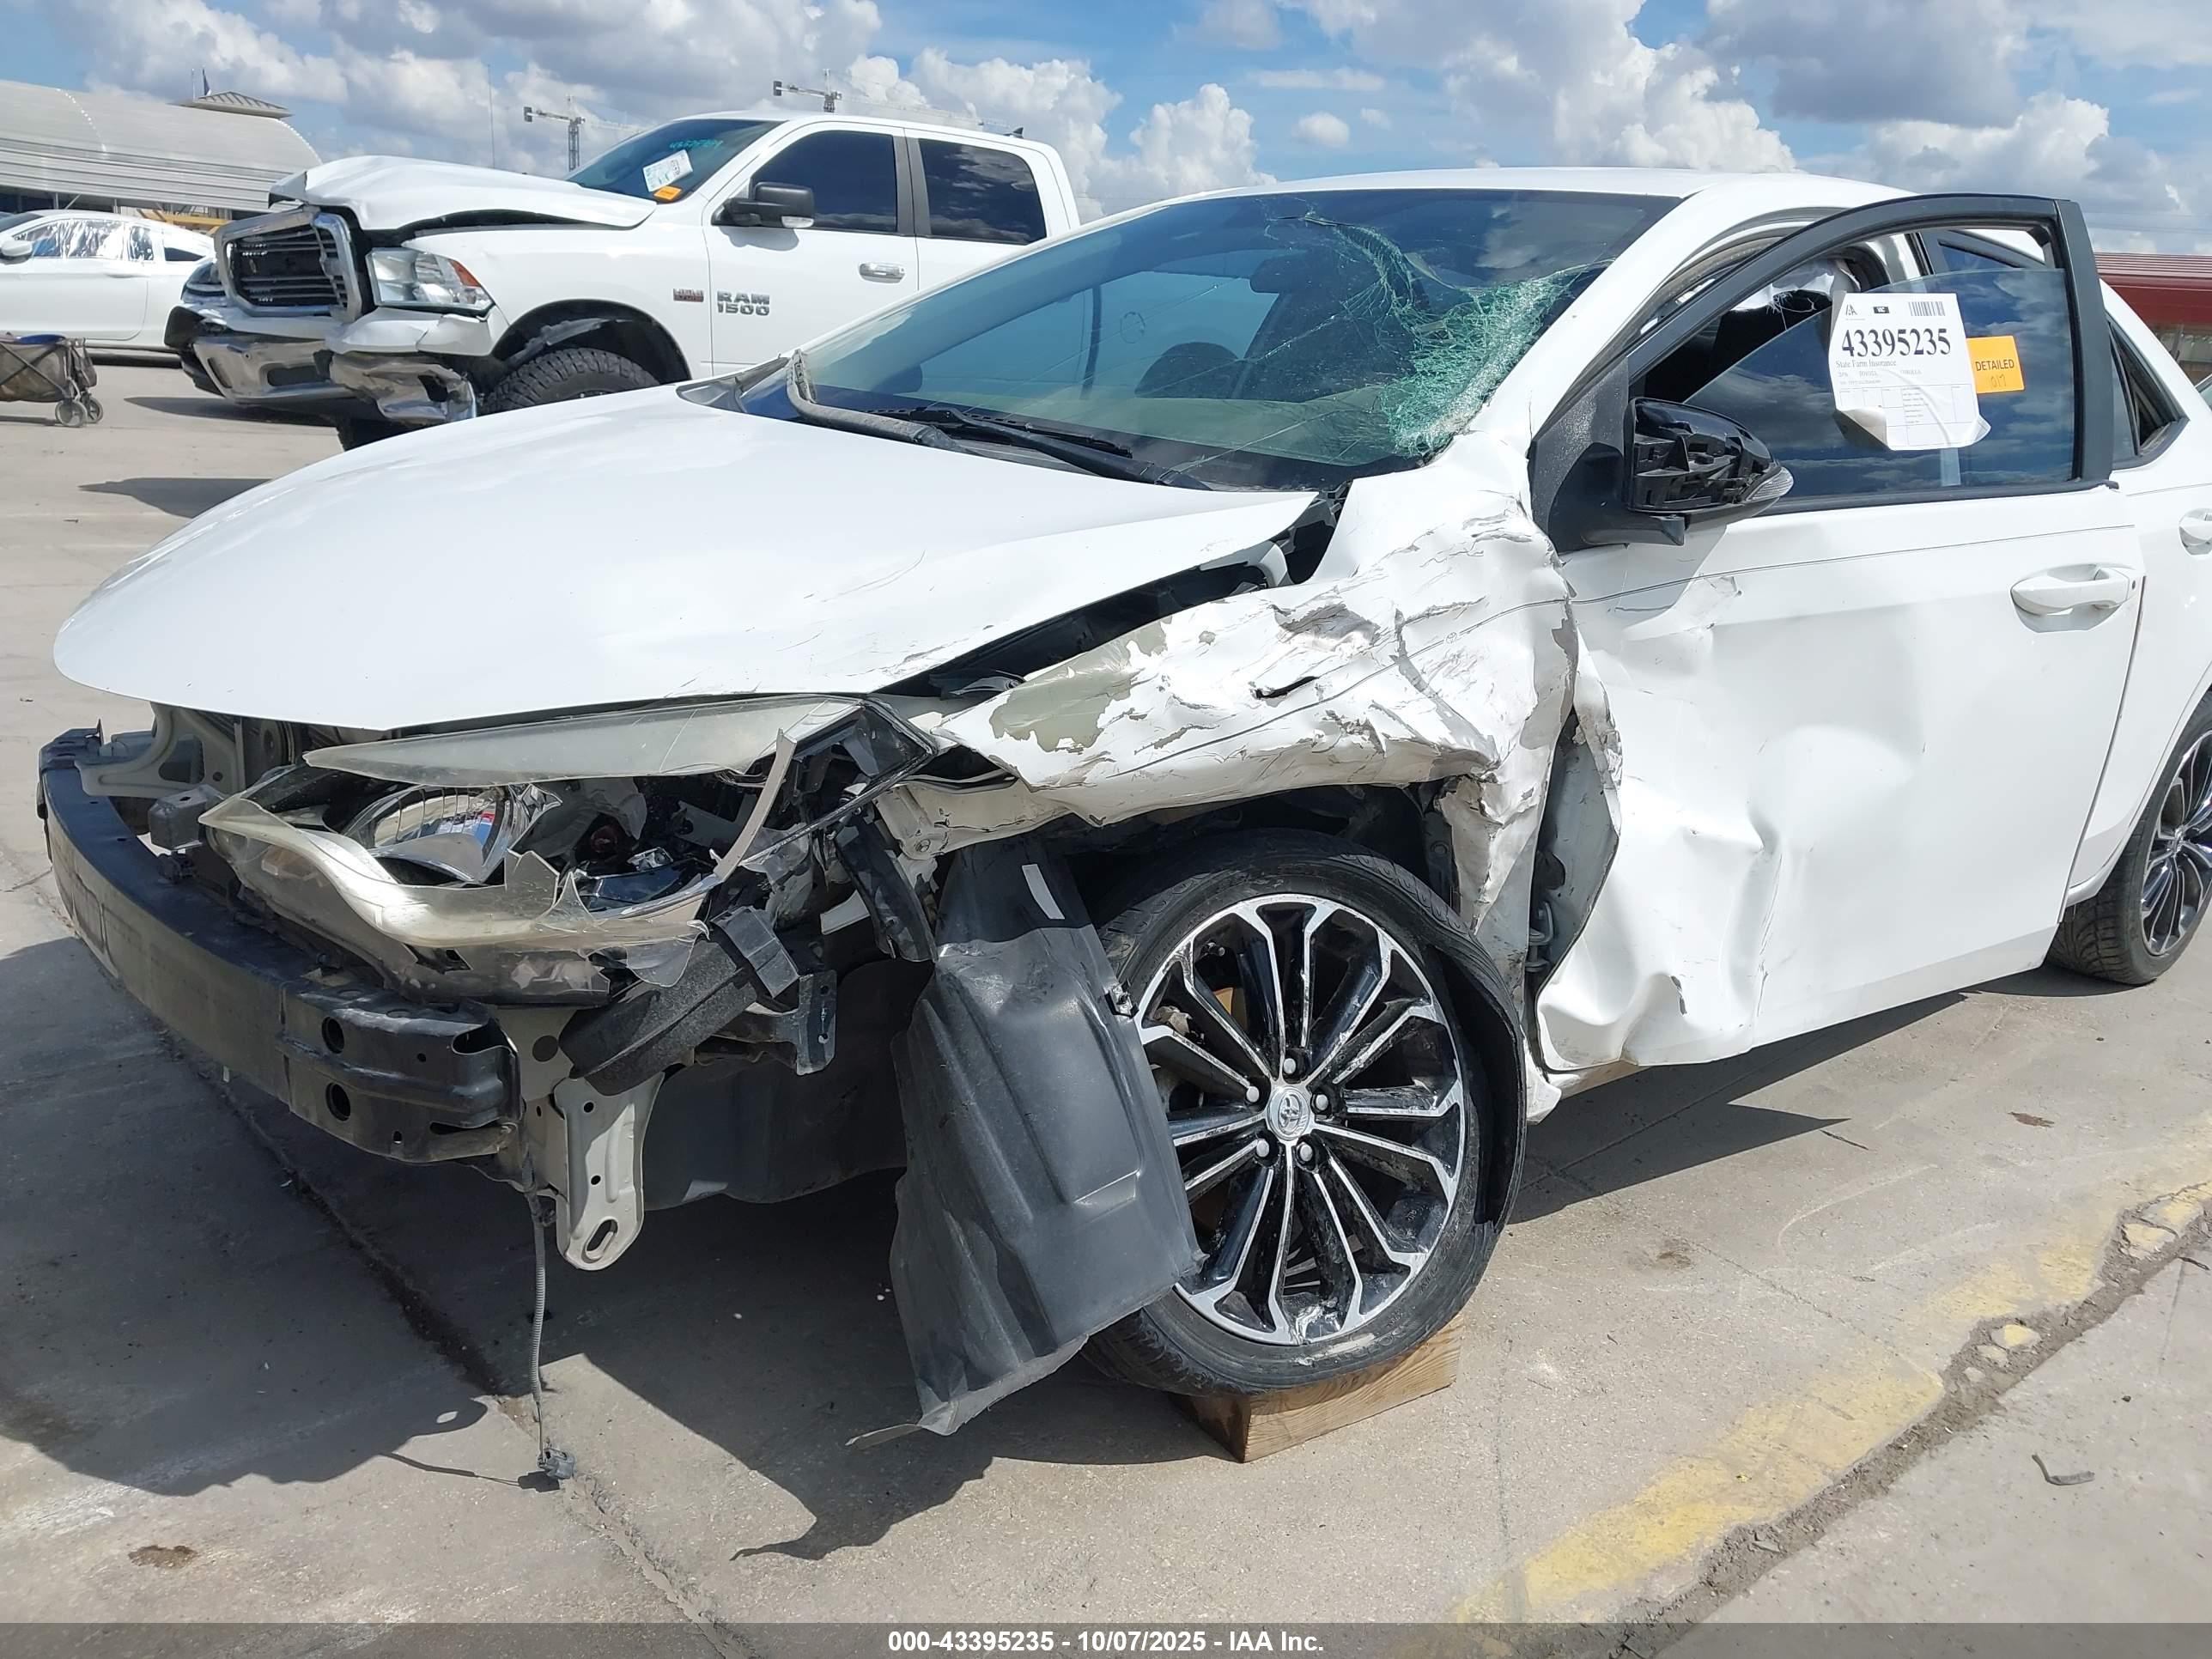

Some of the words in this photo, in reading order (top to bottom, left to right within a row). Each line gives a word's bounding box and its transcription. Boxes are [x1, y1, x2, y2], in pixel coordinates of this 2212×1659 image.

[717, 291, 769, 305] RAM
[718, 302, 769, 316] 1500
[1842, 328, 1951, 357] 43395235
[1836, 360, 1851, 368] State
[1975, 359, 2014, 372] DETAILED
